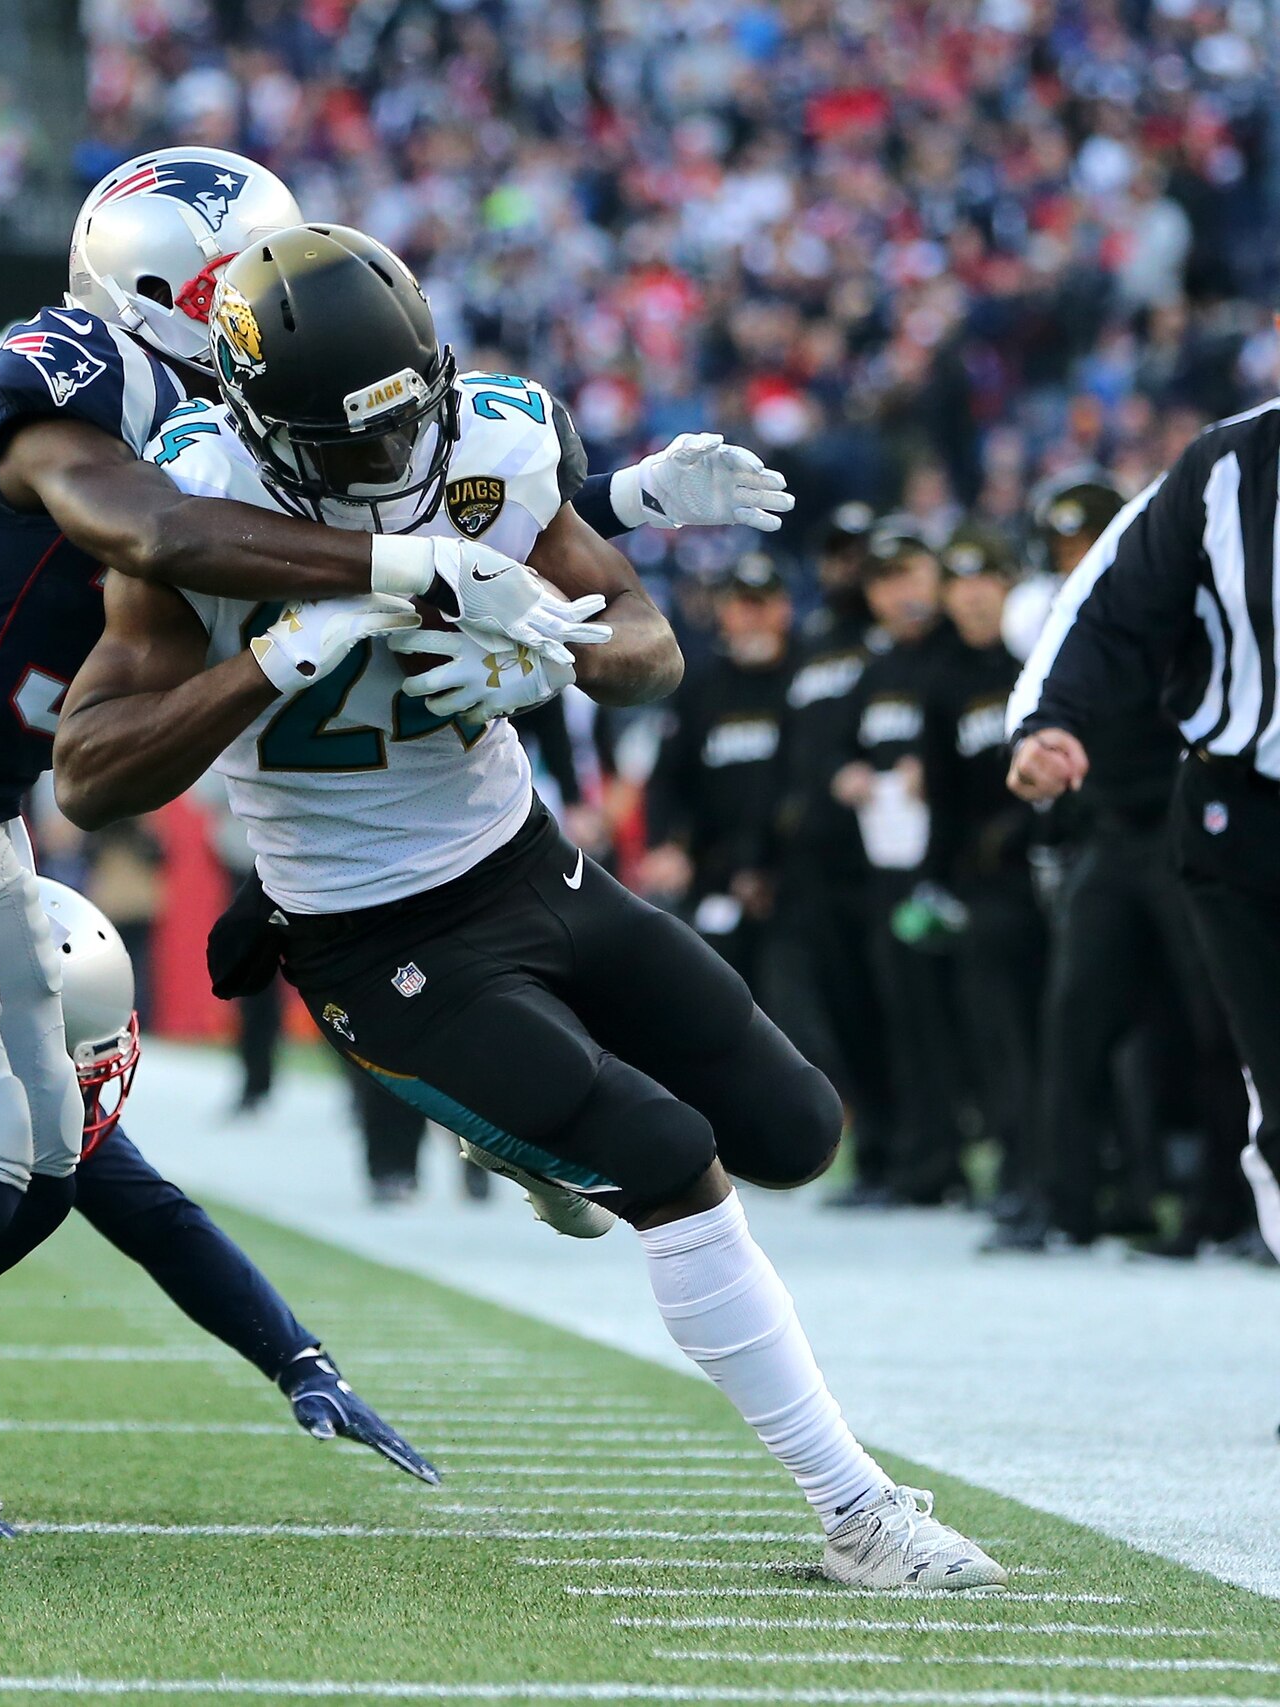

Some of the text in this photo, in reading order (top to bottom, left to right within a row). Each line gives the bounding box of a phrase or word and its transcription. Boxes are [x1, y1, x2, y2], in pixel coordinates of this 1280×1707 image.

[365, 379, 404, 409] JAGS
[450, 479, 502, 506] JAGS
[400, 973, 423, 994] NFL
